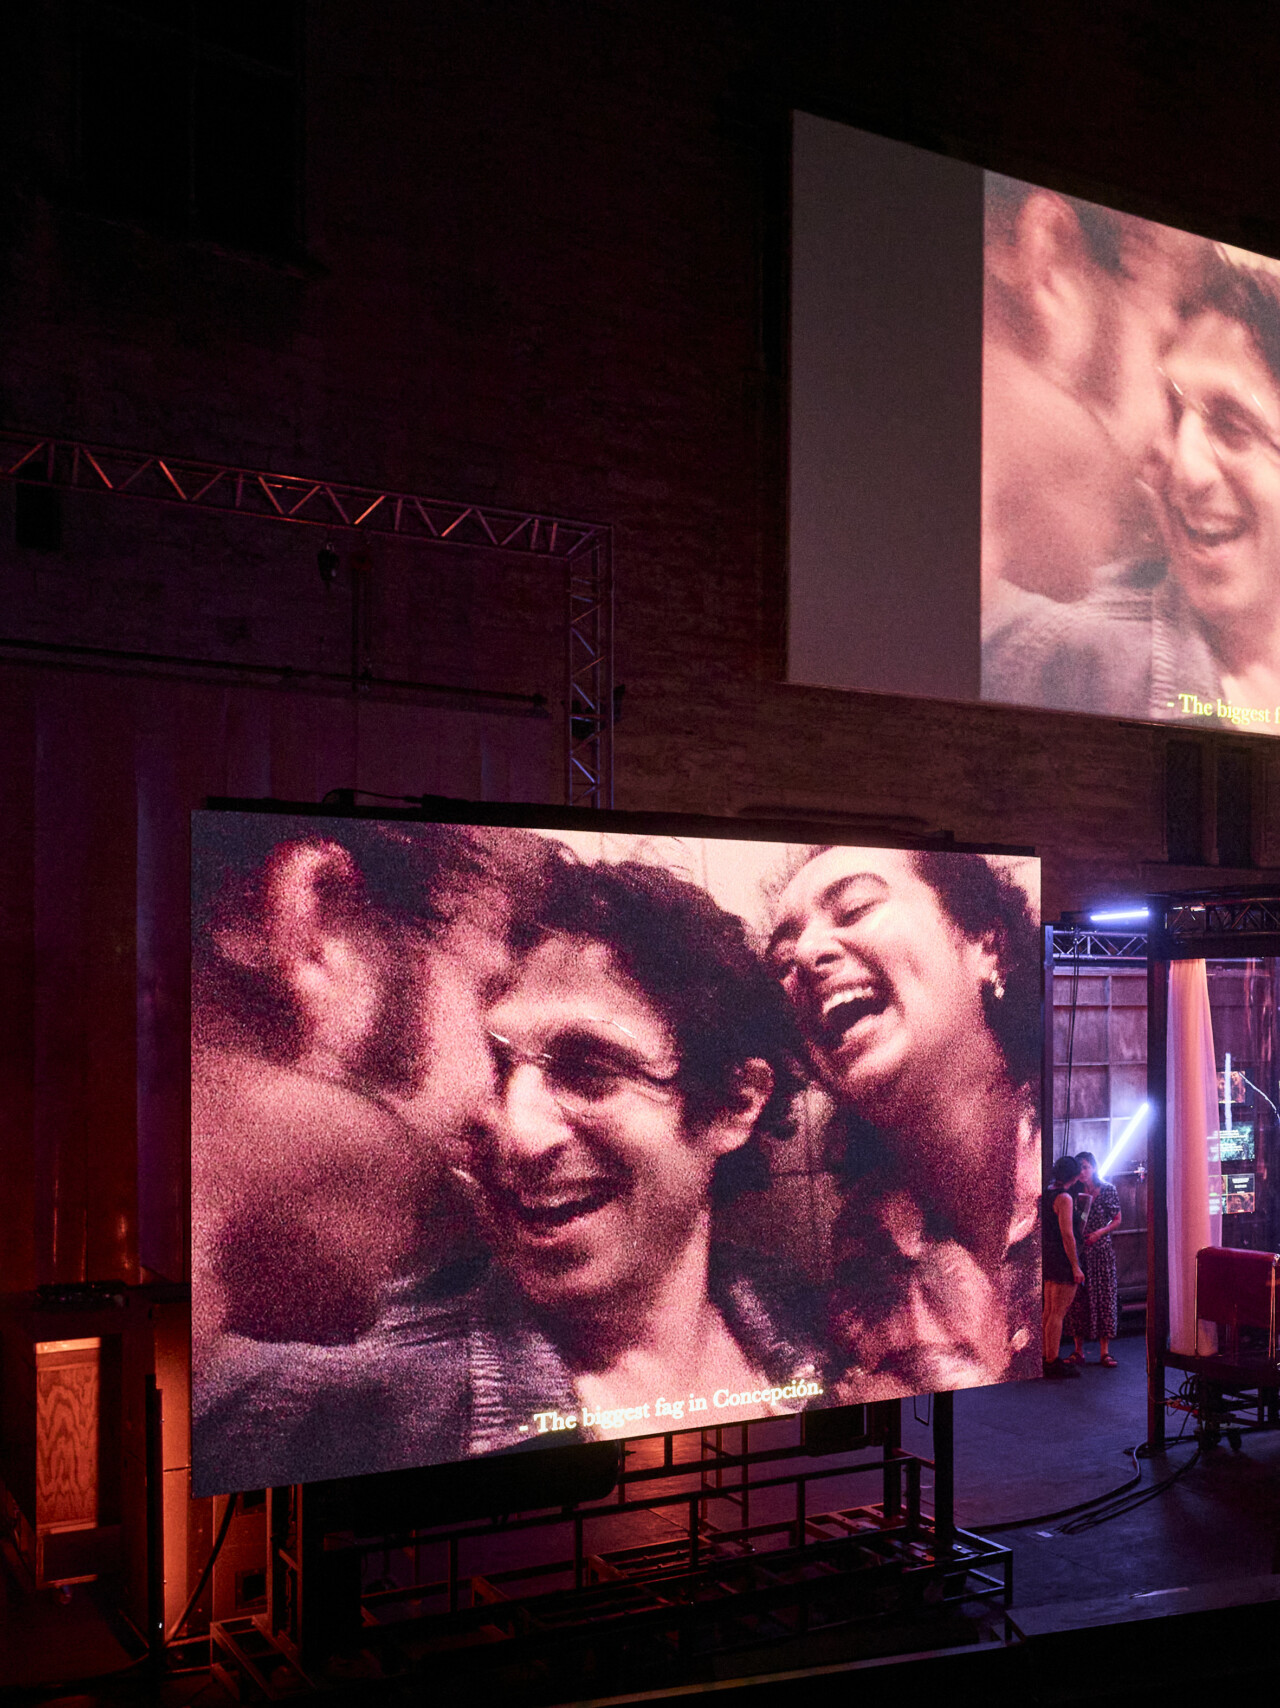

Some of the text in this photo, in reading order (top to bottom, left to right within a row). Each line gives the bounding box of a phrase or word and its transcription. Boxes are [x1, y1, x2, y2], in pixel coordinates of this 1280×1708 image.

[1178, 694, 1212, 716] The
[1217, 698, 1270, 725] biggest
[533, 1411, 577, 1433] The
[582, 1403, 650, 1429] biggest
[655, 1398, 685, 1419] fag
[688, 1394, 707, 1412] in
[712, 1380, 824, 1409] Concepción.
